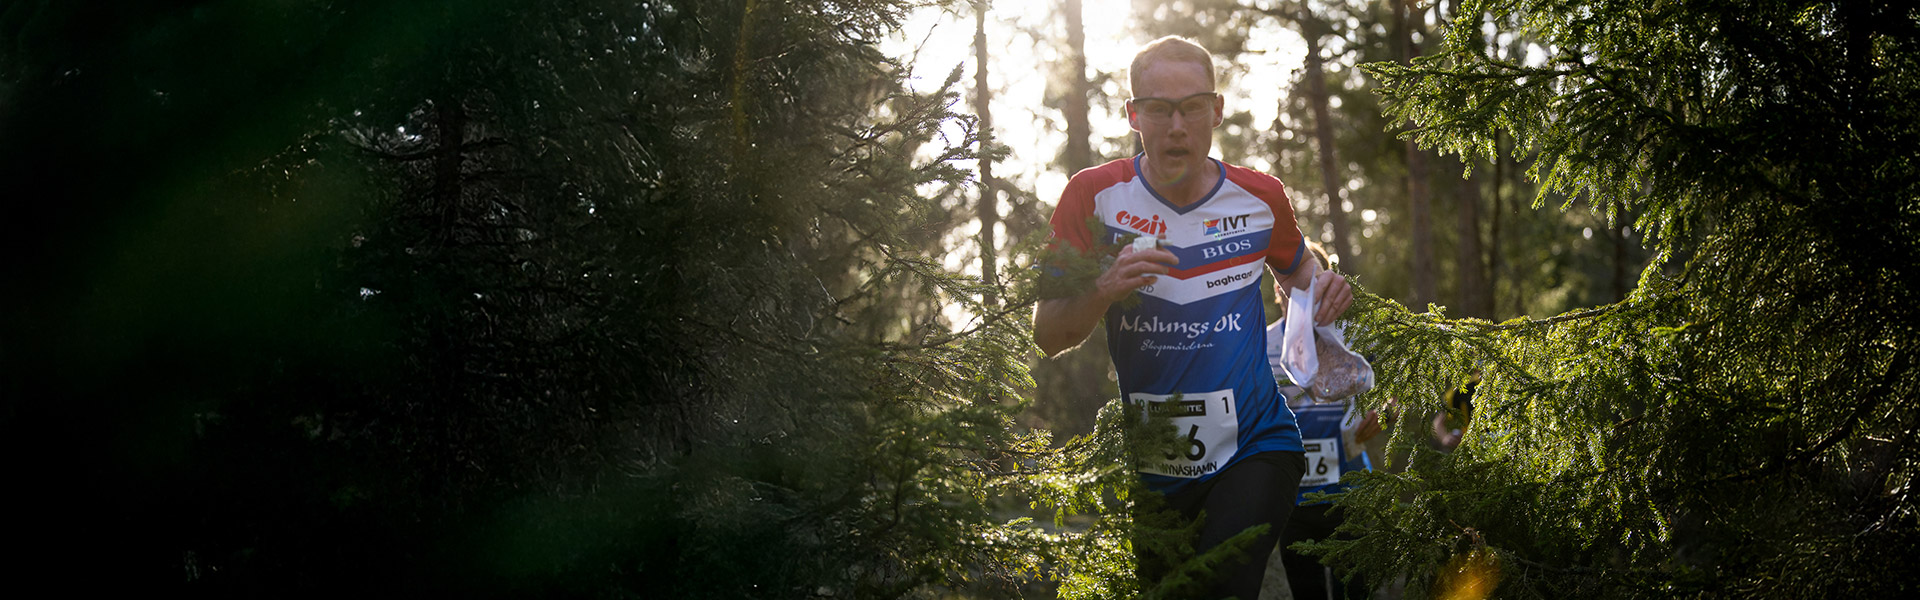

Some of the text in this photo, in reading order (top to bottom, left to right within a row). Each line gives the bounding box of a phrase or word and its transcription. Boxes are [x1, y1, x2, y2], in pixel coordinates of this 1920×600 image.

[1116, 210, 1167, 236] emit
[1223, 213, 1250, 232] IVT
[1202, 239, 1252, 260] BIOS
[1119, 313, 1242, 339] Malungs OK
[1221, 396, 1230, 414] 1
[1329, 441, 1335, 452] 1
